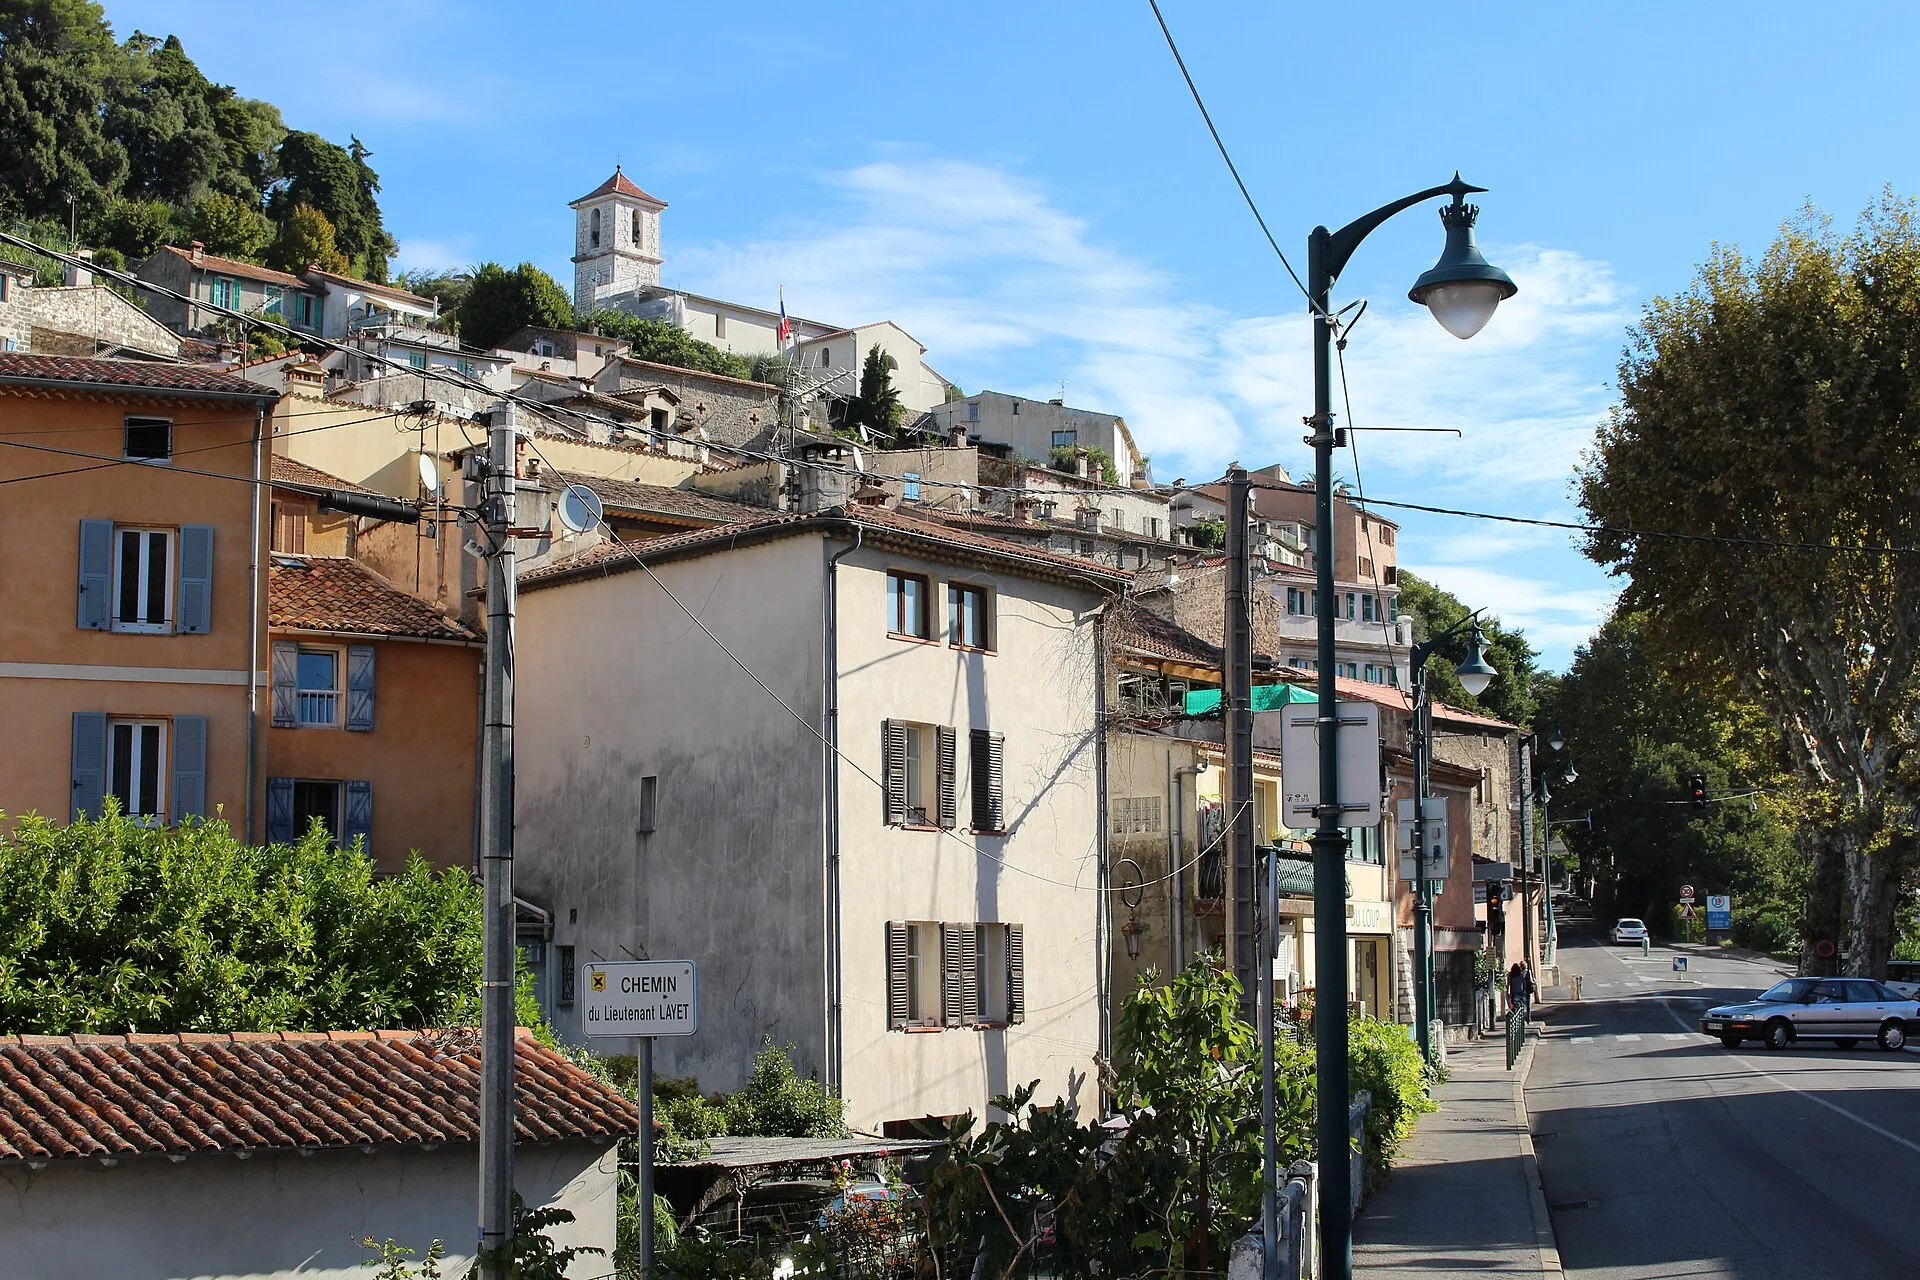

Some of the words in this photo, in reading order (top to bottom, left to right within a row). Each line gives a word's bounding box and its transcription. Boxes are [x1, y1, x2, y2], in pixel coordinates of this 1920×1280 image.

[1363, 908, 1379, 927] LOUP
[621, 976, 677, 993] CHEMIN
[588, 1005, 600, 1021] du
[604, 1005, 655, 1021] Lieutenant
[659, 1003, 689, 1020] LAYET
